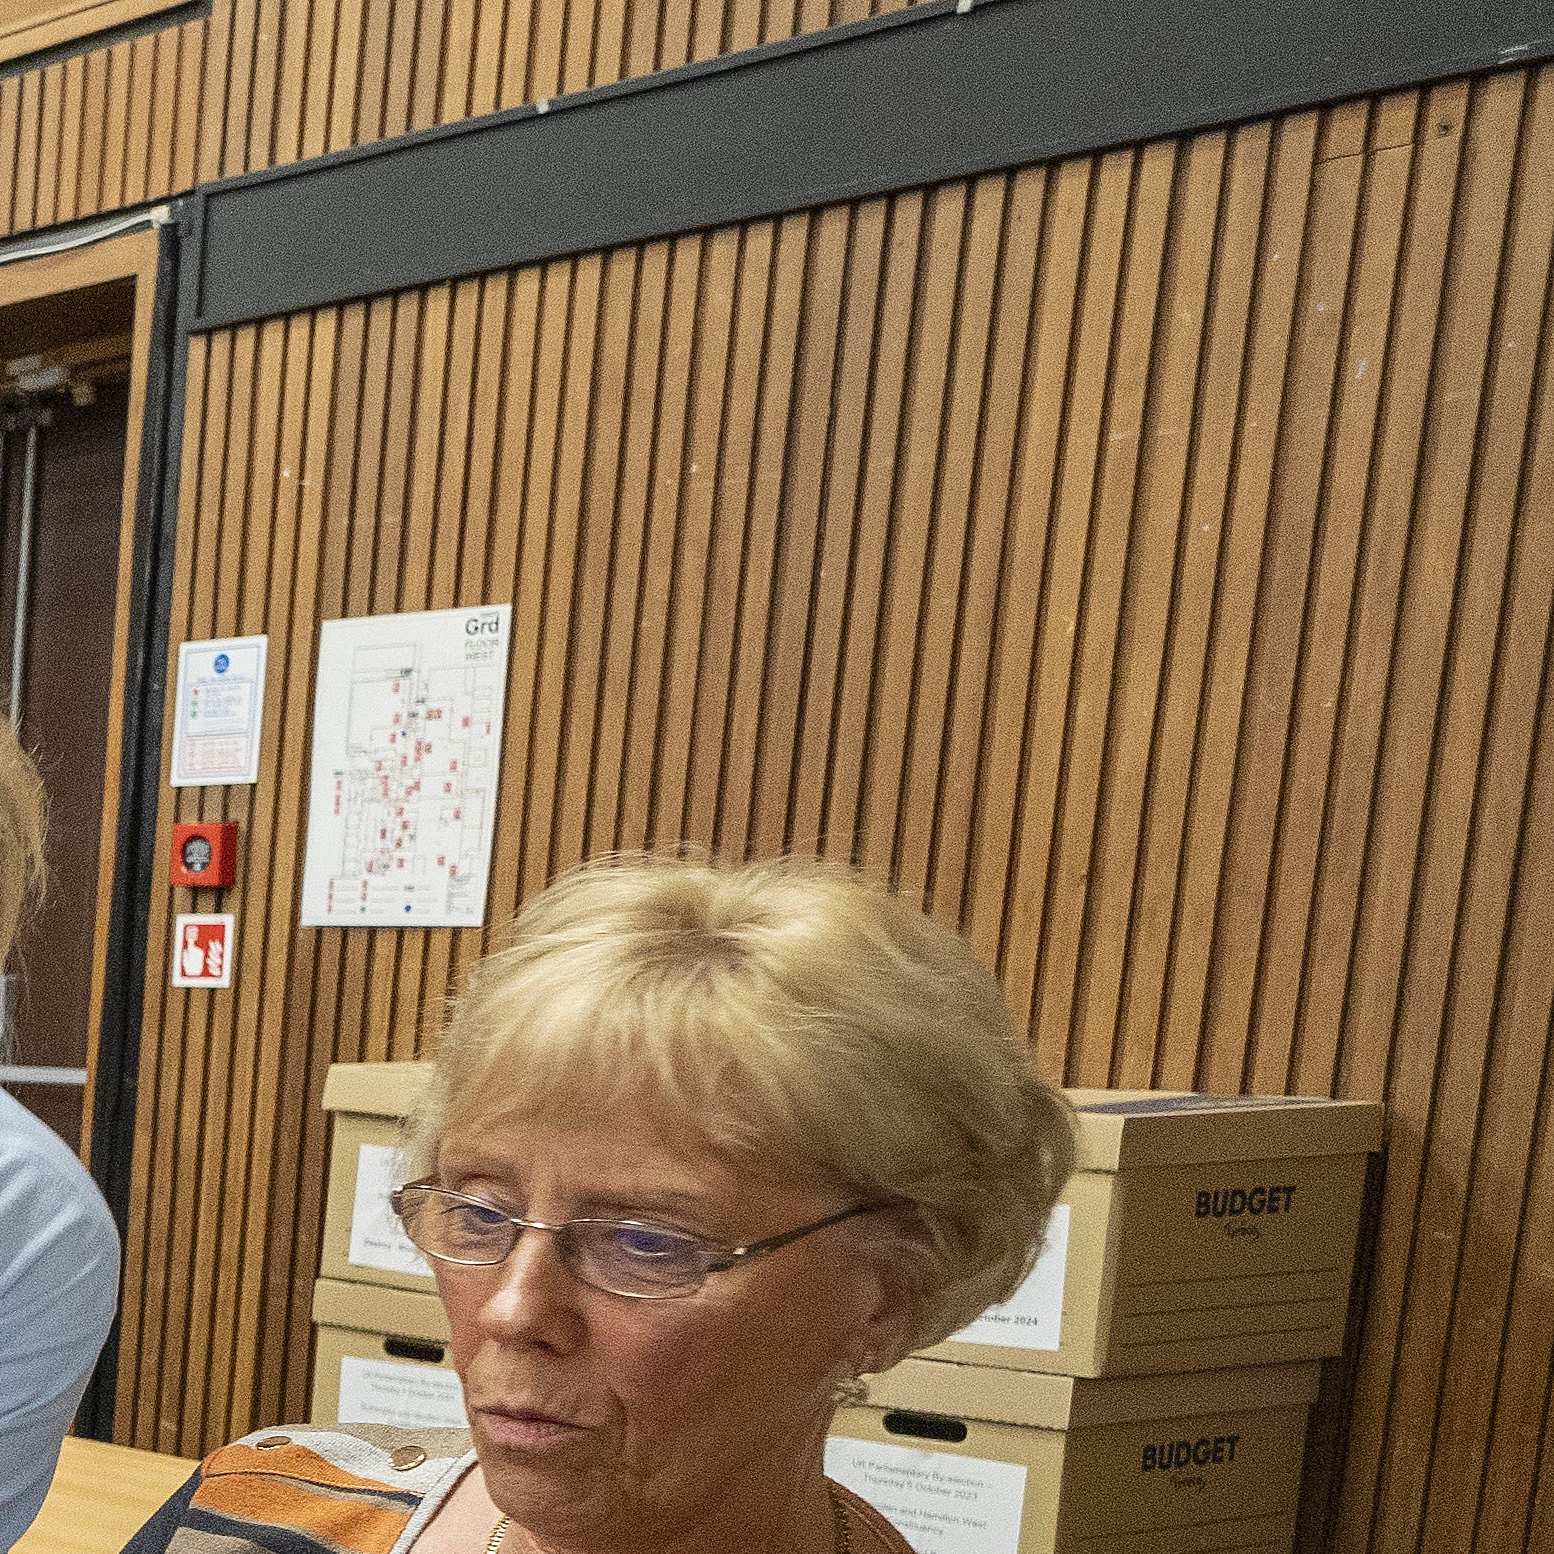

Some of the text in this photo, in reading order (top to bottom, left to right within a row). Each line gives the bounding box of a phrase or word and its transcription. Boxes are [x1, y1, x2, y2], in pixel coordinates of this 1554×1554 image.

[464, 612, 500, 637] Grd
[1194, 1183, 1296, 1220] BUDGET
[1013, 1316, 1038, 1326] 2024
[1141, 1434, 1239, 1472] BUDGET
